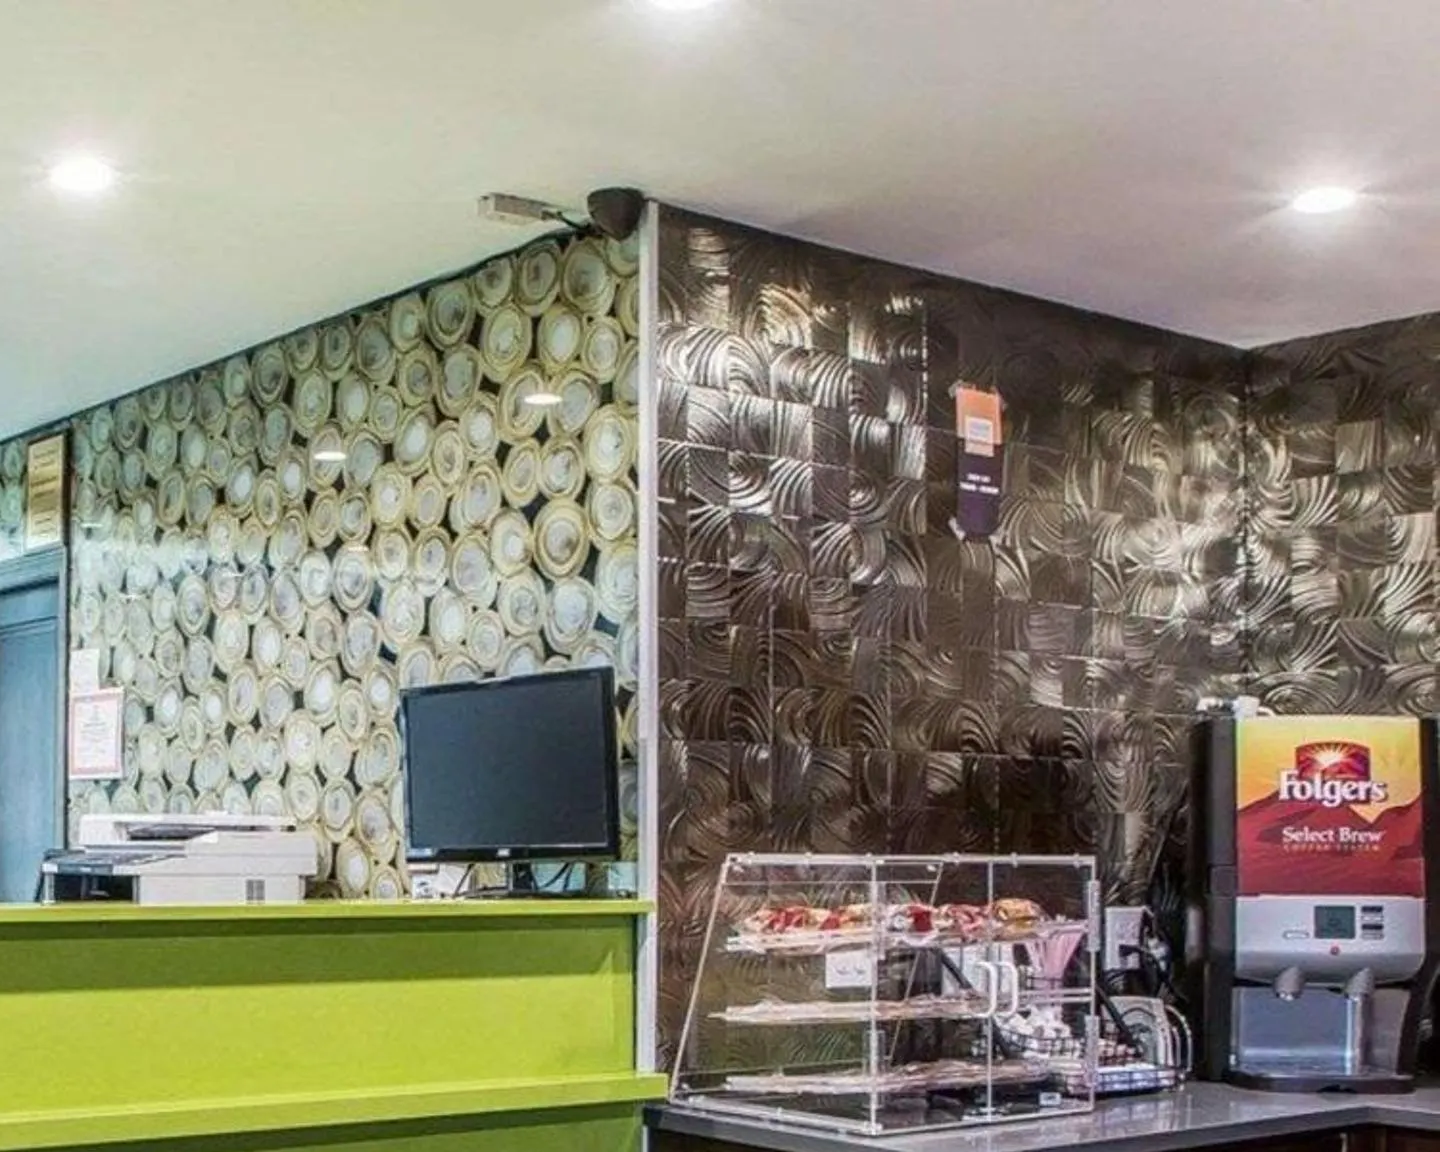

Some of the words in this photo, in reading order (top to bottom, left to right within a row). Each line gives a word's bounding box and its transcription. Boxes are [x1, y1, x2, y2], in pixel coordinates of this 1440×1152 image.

[1279, 769, 1387, 807] Folgers
[1282, 826, 1335, 843] Select
[1339, 826, 1386, 843] Brew
